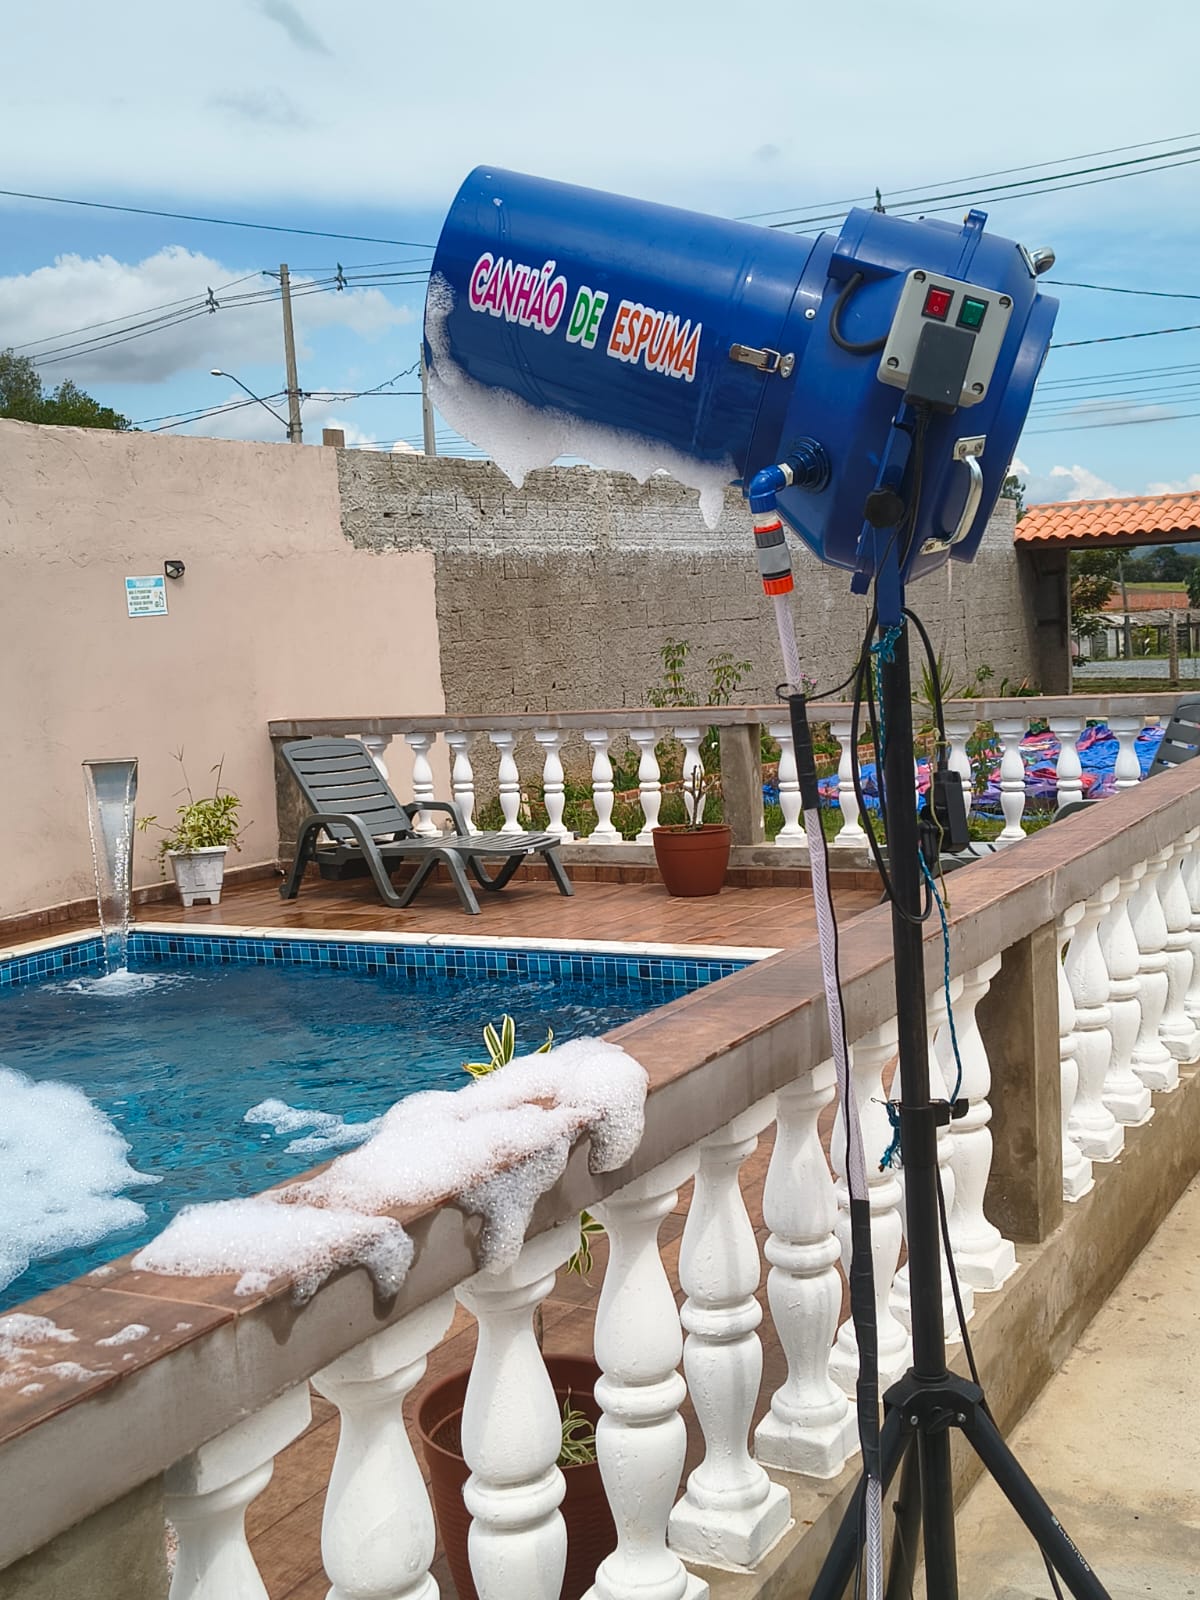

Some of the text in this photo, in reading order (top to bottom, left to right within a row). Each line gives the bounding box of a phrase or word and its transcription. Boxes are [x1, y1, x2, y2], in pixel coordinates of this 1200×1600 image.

[470, 254, 700, 380] CANHÃO DE ESPUMA
